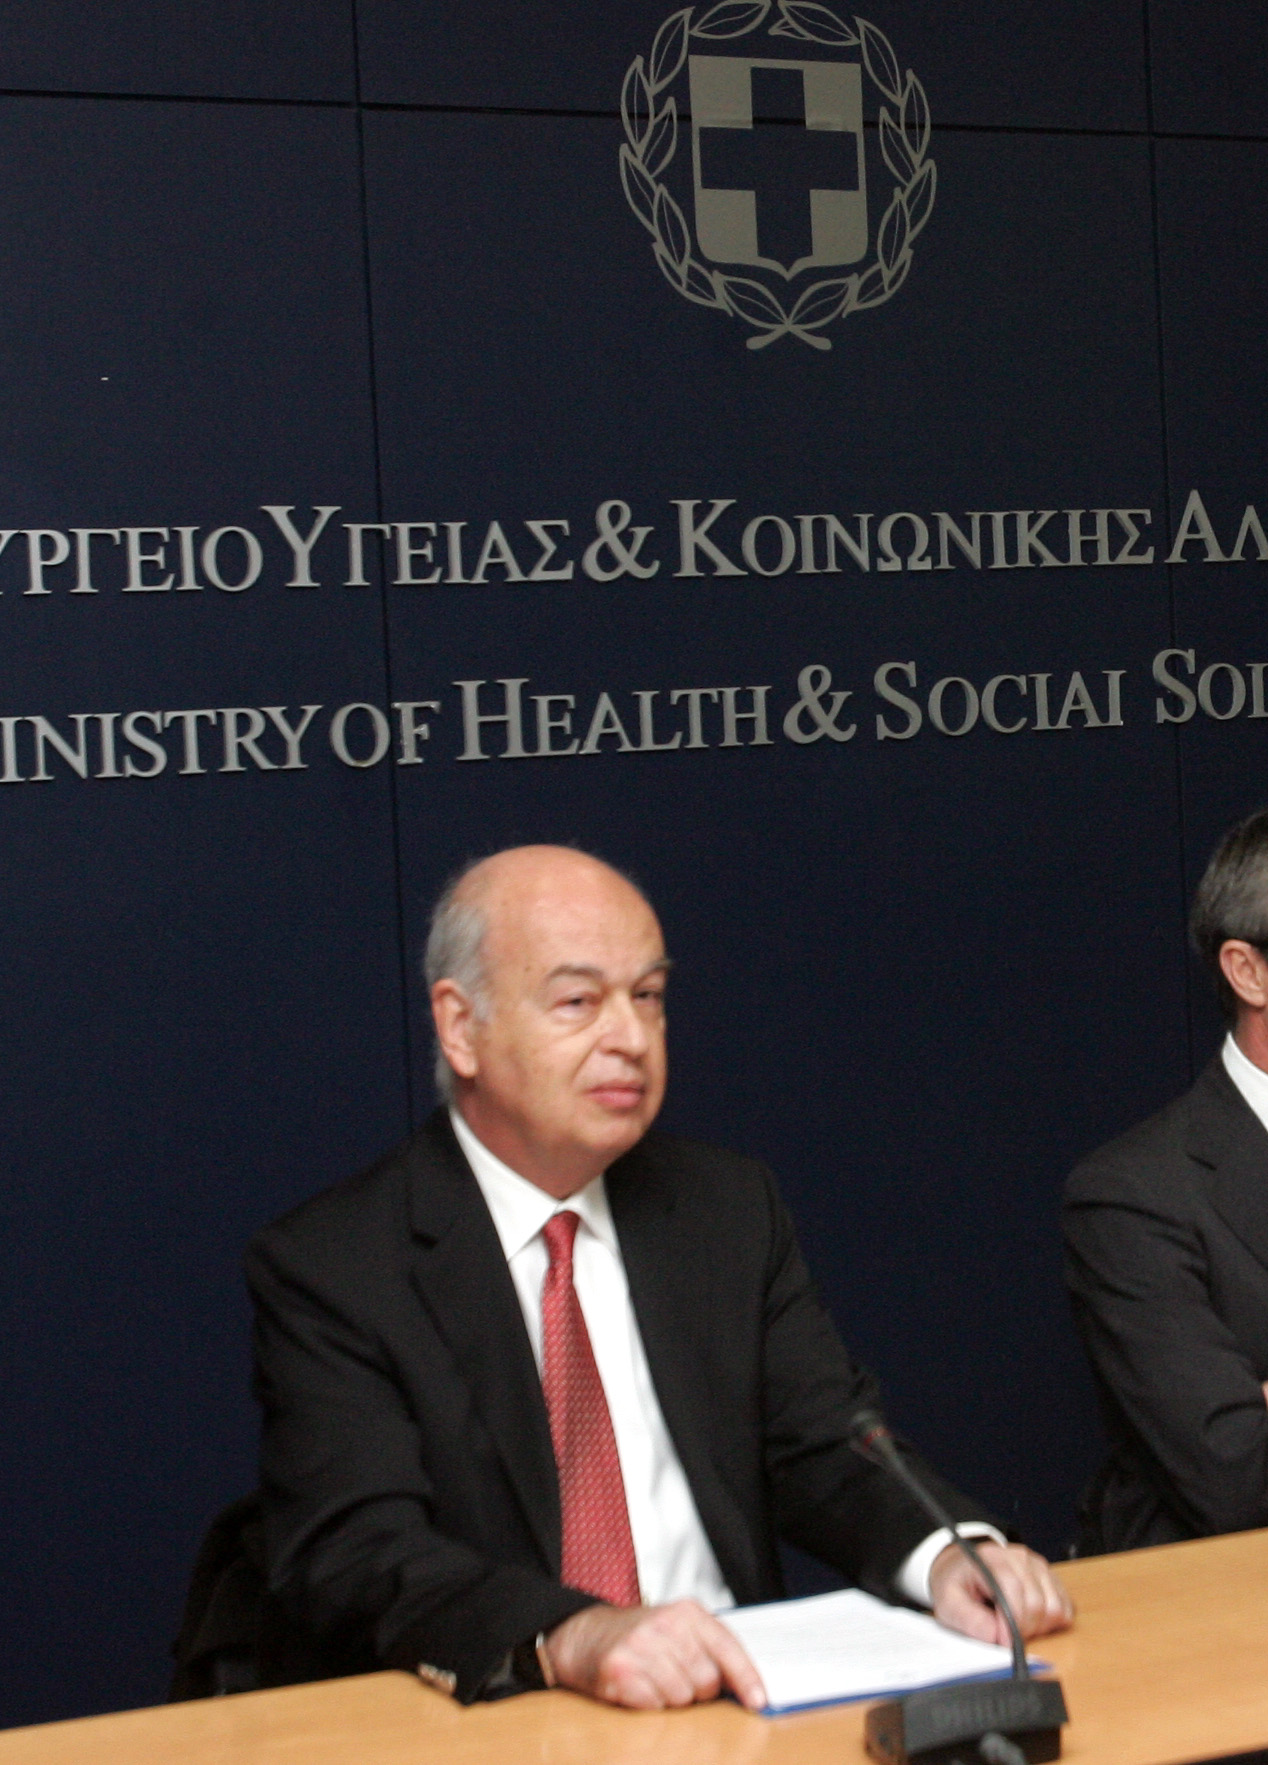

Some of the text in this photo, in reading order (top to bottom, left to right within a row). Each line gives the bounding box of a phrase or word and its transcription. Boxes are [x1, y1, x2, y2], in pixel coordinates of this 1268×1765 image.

[261, 504, 574, 587] ΥΓΕΙΑΣ
[582, 499, 660, 582] &
[669, 498, 1154, 578] ΚΟΙΝΩΝΙΚΗΣ
[330, 700, 440, 768] OF
[453, 677, 773, 761] HEALTH
[783, 664, 857, 743] &
